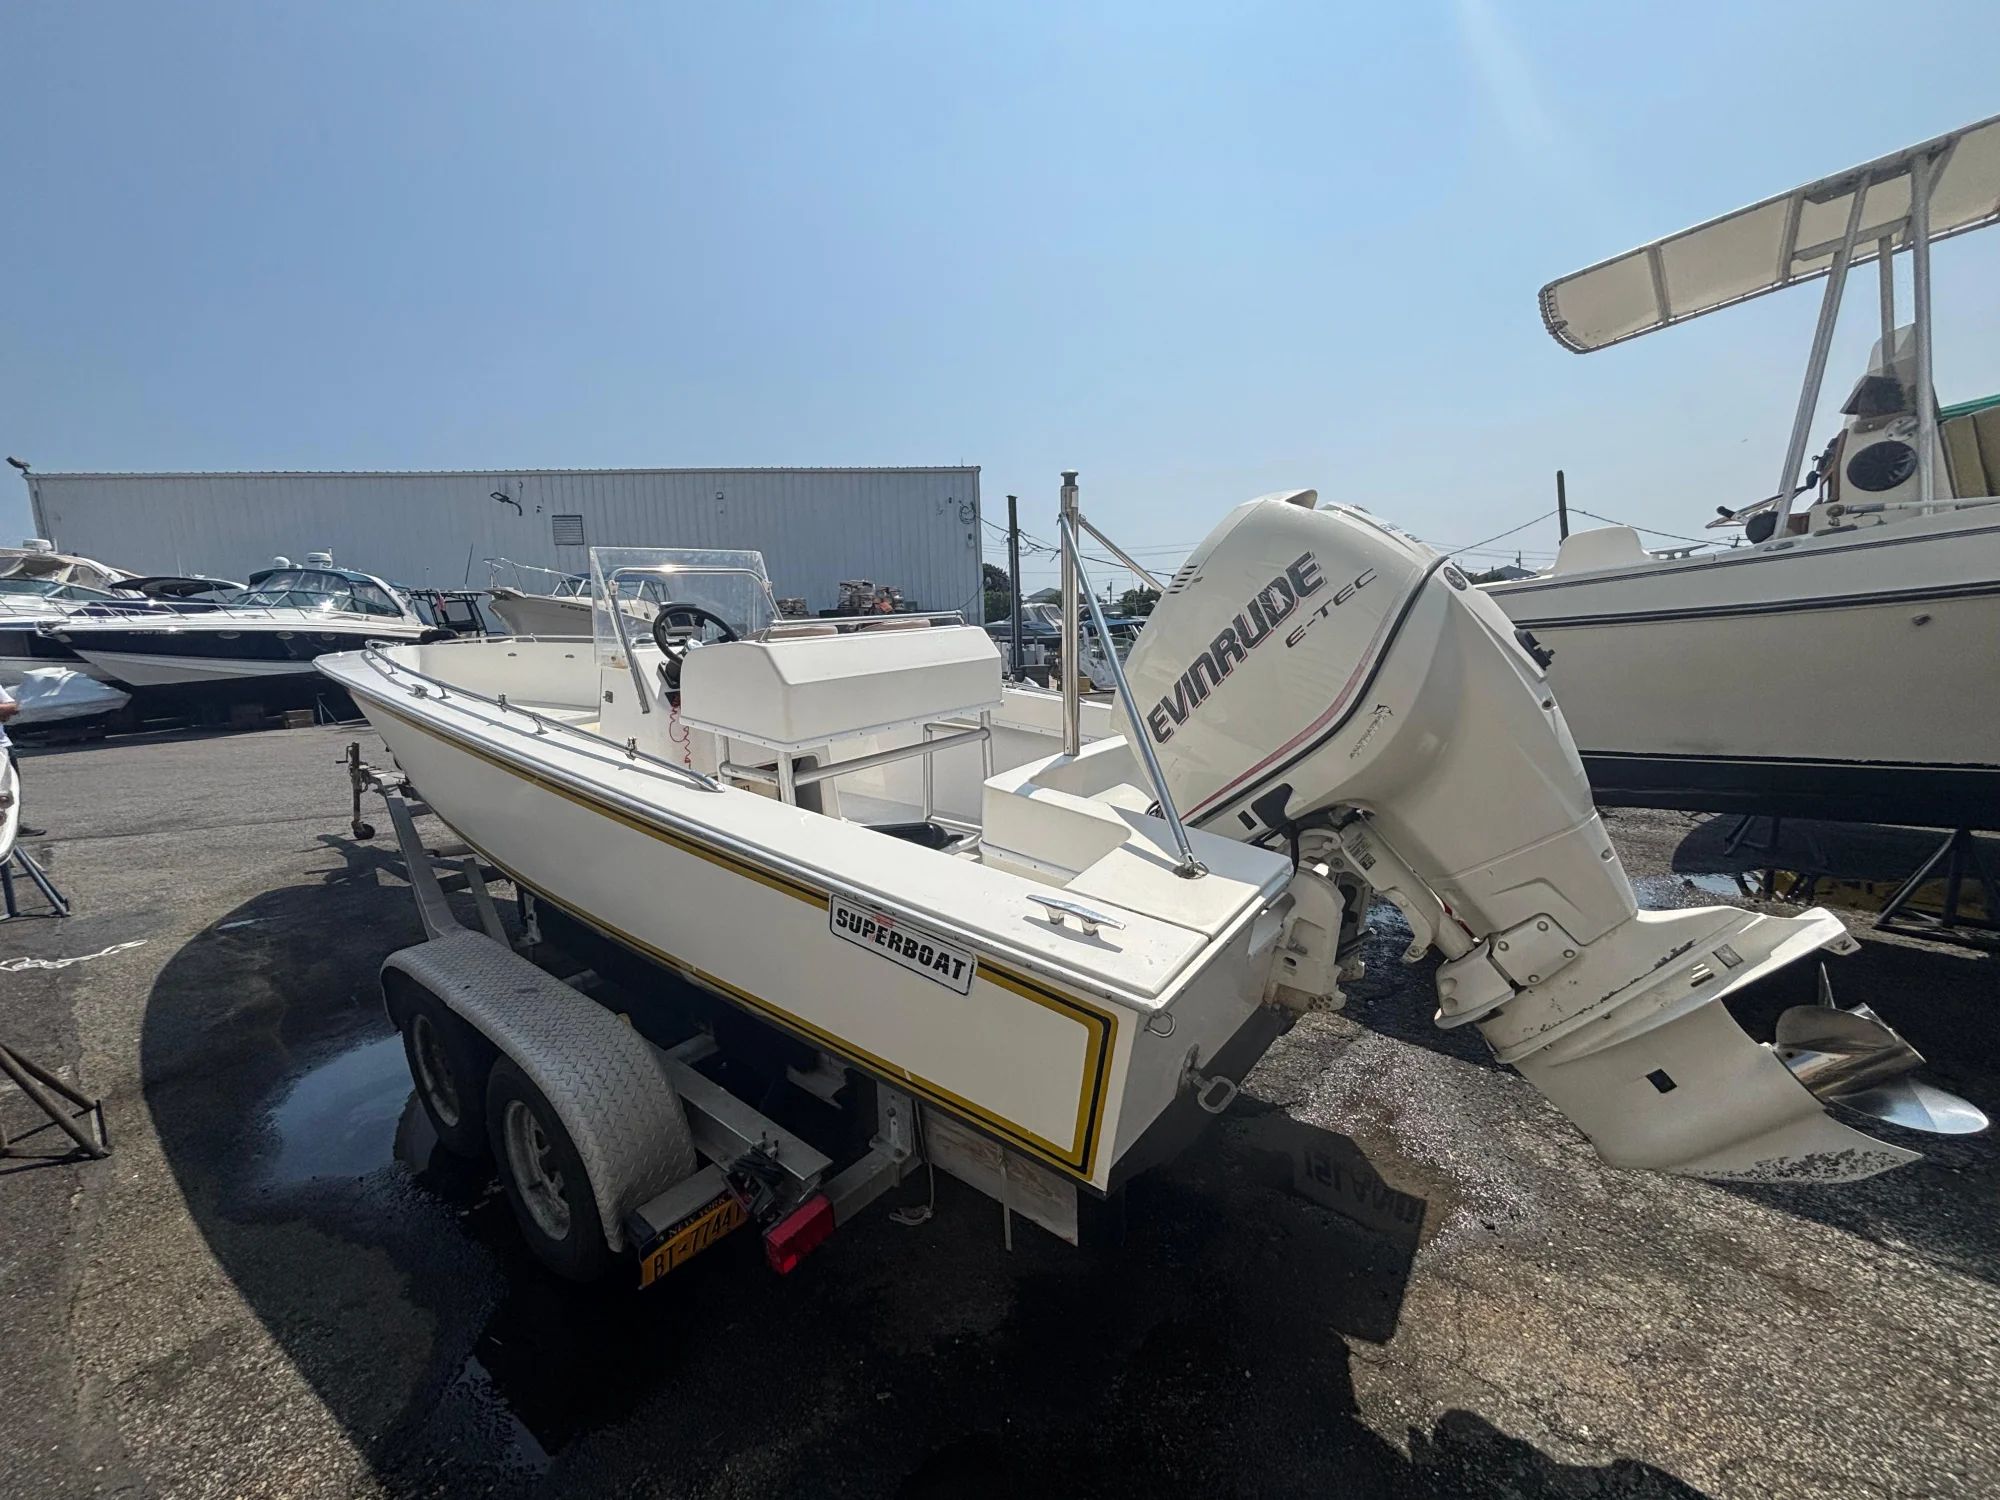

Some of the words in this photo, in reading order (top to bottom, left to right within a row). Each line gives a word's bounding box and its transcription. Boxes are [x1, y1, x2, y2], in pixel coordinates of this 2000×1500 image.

[1285, 568, 1377, 648] E-TEC
[1147, 551, 1327, 744] EVINRUDE
[835, 908, 966, 980] SUPERBOAT
[668, 1216, 695, 1238] NEW
[699, 1194, 726, 1217] YORK
